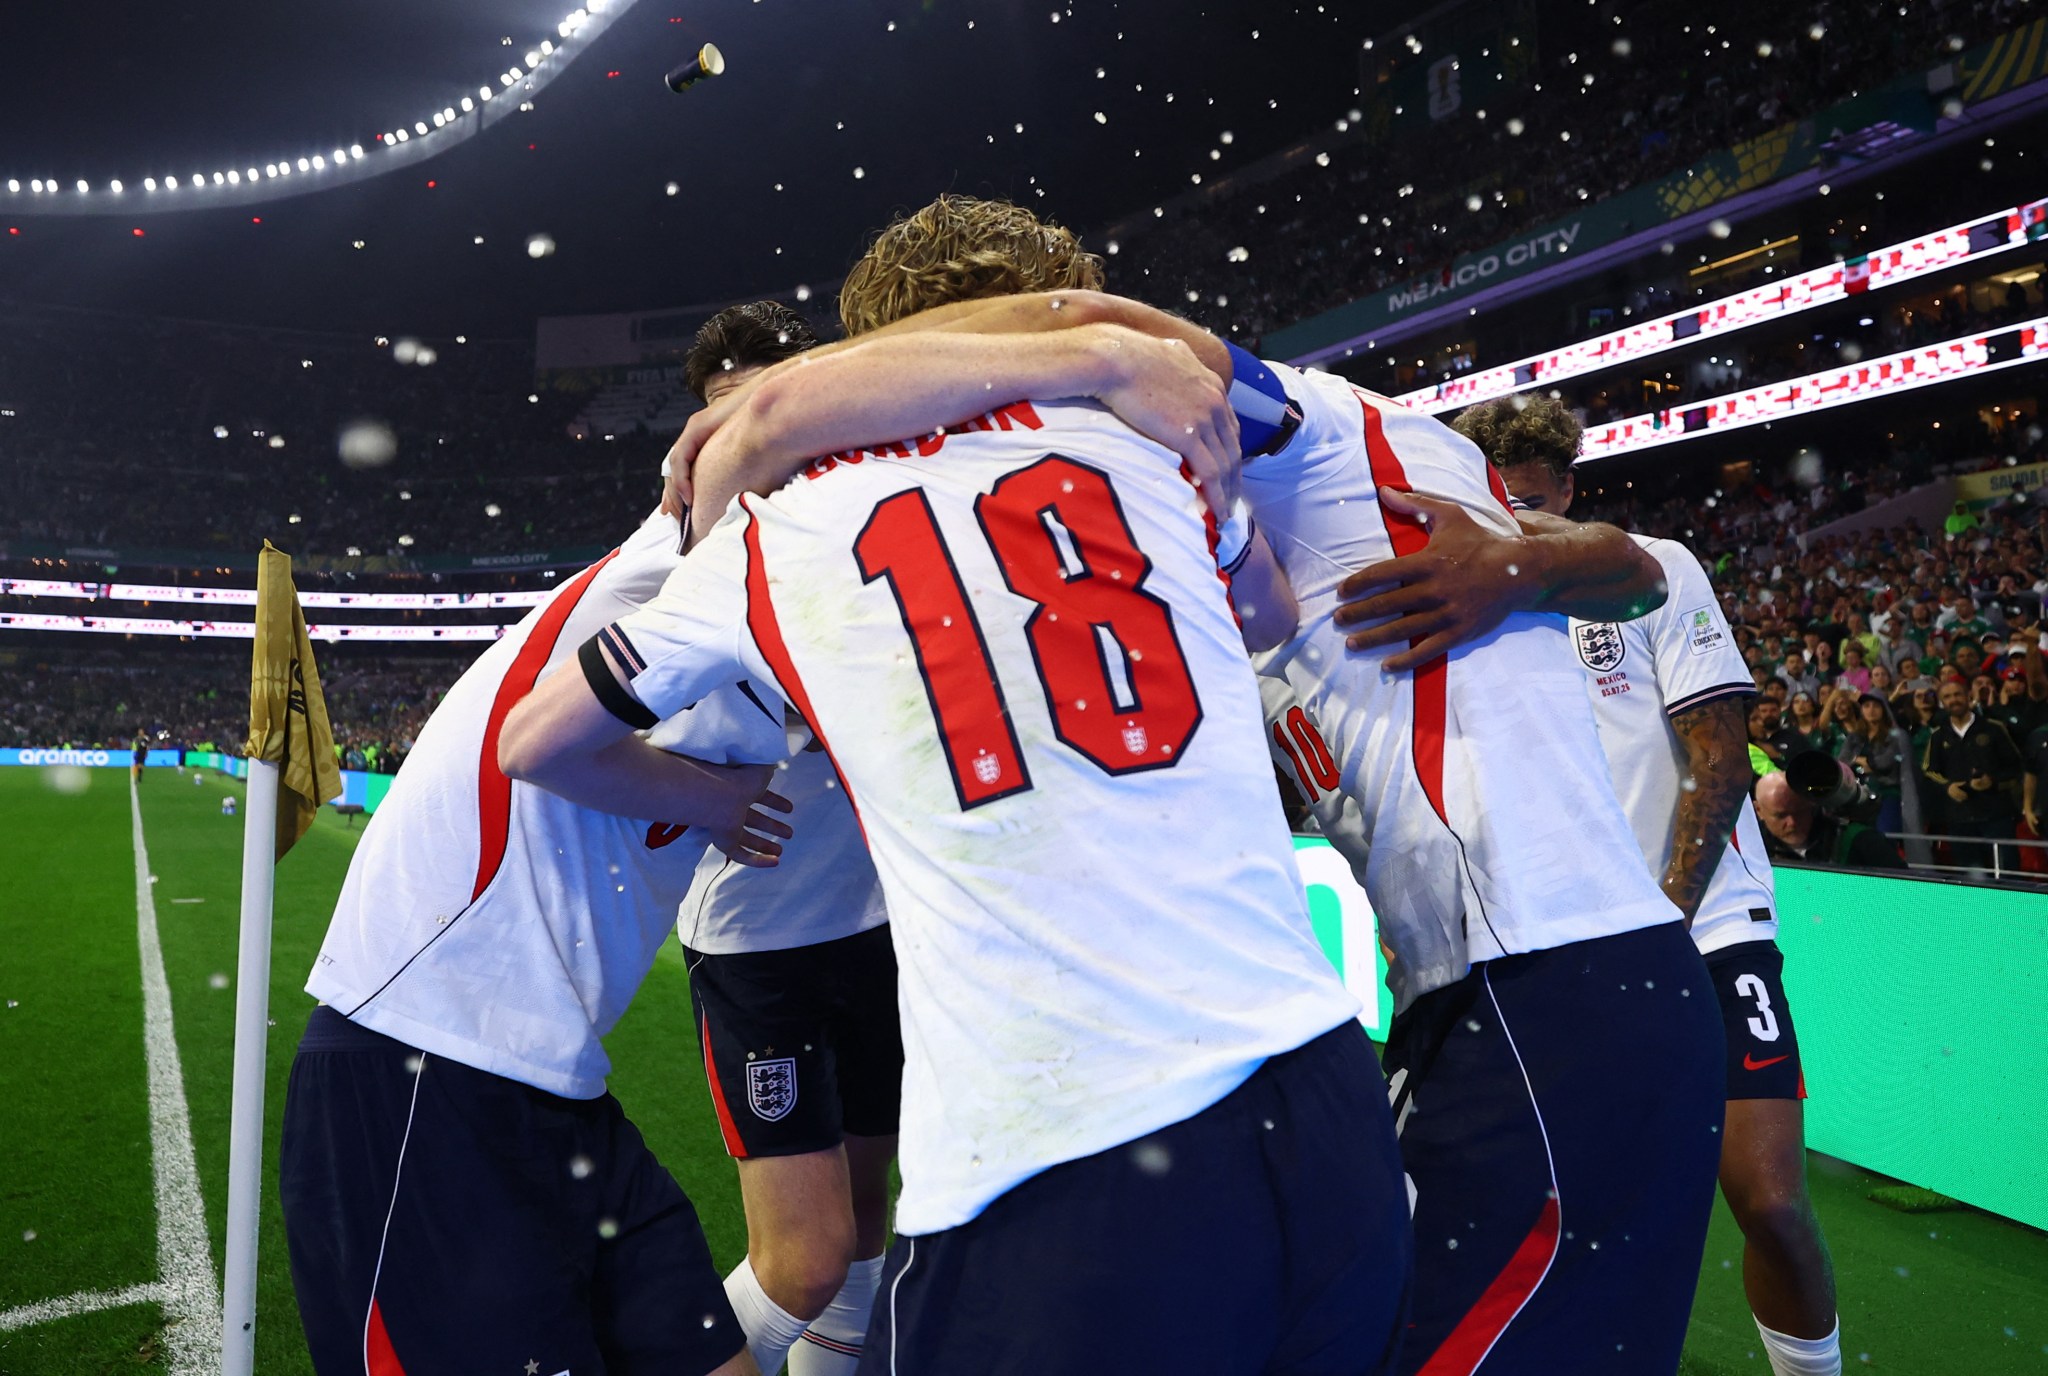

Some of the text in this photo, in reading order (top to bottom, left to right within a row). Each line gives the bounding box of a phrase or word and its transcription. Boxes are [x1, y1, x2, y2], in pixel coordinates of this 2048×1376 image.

[1388, 222, 1581, 312] MEXICO CITY
[852, 452, 1205, 812] 18
[1693, 632, 1722, 646] EDUCATION
[1596, 672, 1626, 686] MEXICO
[18, 749, 109, 766] aramco
[1273, 705, 1340, 804] 10
[1735, 974, 1780, 1042] 3
